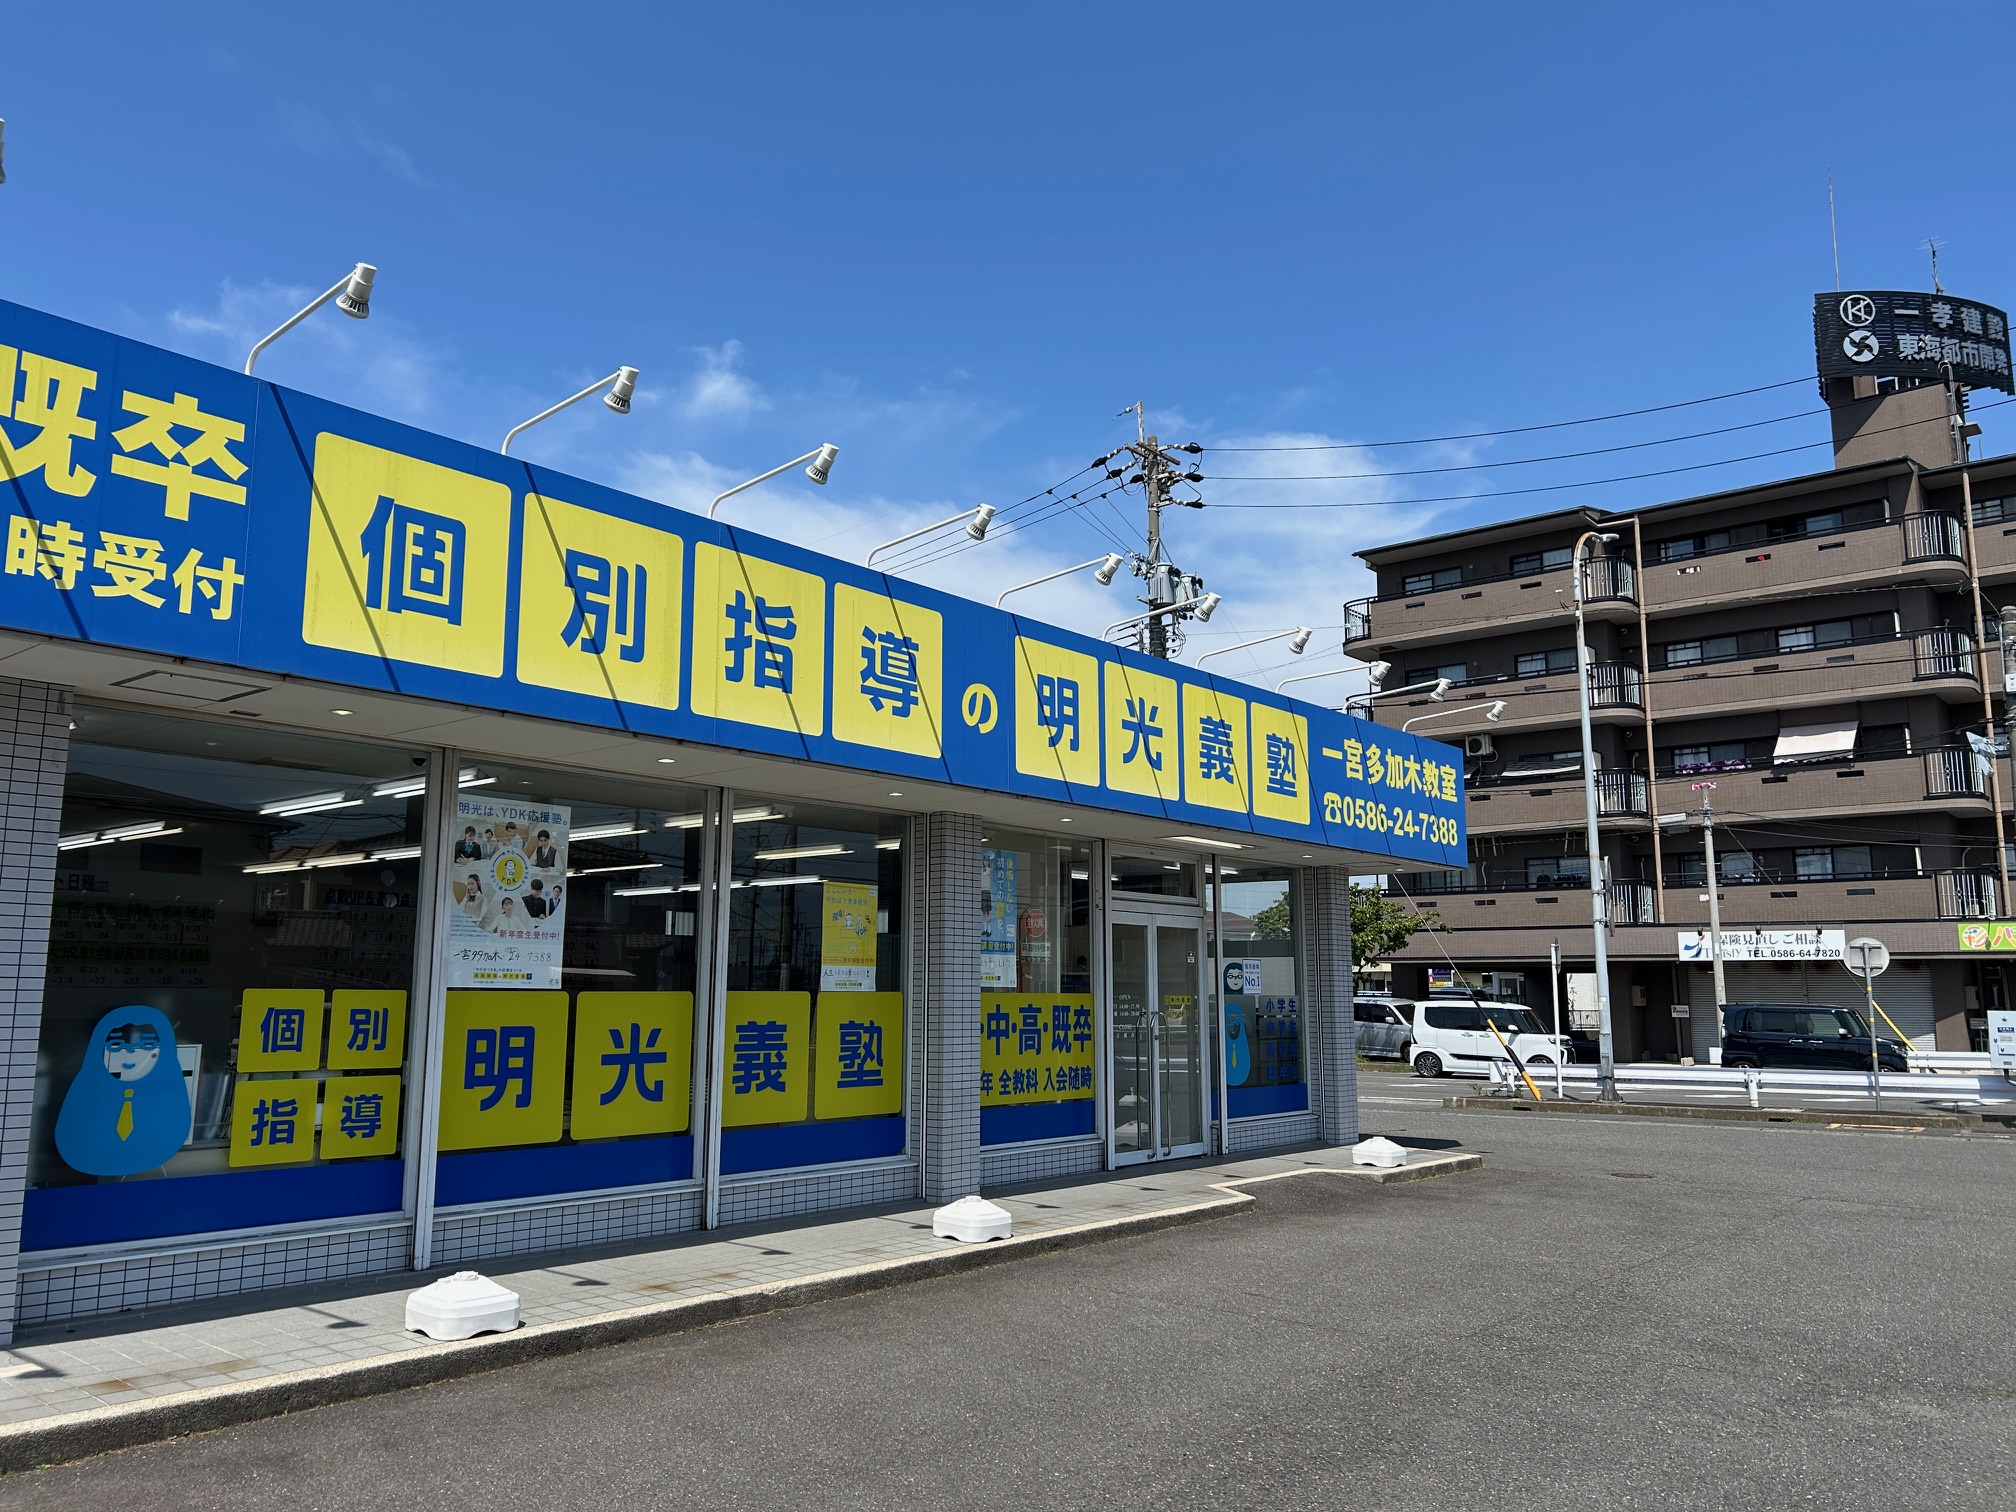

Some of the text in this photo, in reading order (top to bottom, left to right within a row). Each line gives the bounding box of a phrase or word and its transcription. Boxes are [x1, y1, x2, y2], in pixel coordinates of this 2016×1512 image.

[1894, 301, 2005, 342] 一孝建設
[1897, 333, 2009, 376] 東海都市開発
[5, 514, 245, 621] 時受付
[360, 494, 1298, 798] 個別指導の明光義塾
[1322, 738, 1458, 803] 一宮多加木教室
[458, 801, 568, 826] 明光は、YDK応援塾。
[1342, 796, 1458, 847] 0586-24-7388
[55, 874, 96, 890] 日程
[501, 875, 517, 885] YDK
[996, 857, 1006, 934] 初めてのを。
[1245, 976, 1260, 987] No.1
[1266, 998, 1296, 1013] 小学生
[1266, 1020, 1297, 1036] 中学生
[260, 1006, 389, 1053] 個別
[463, 1019, 884, 1112] 明光義塾
[250, 1093, 383, 1147] 指導
